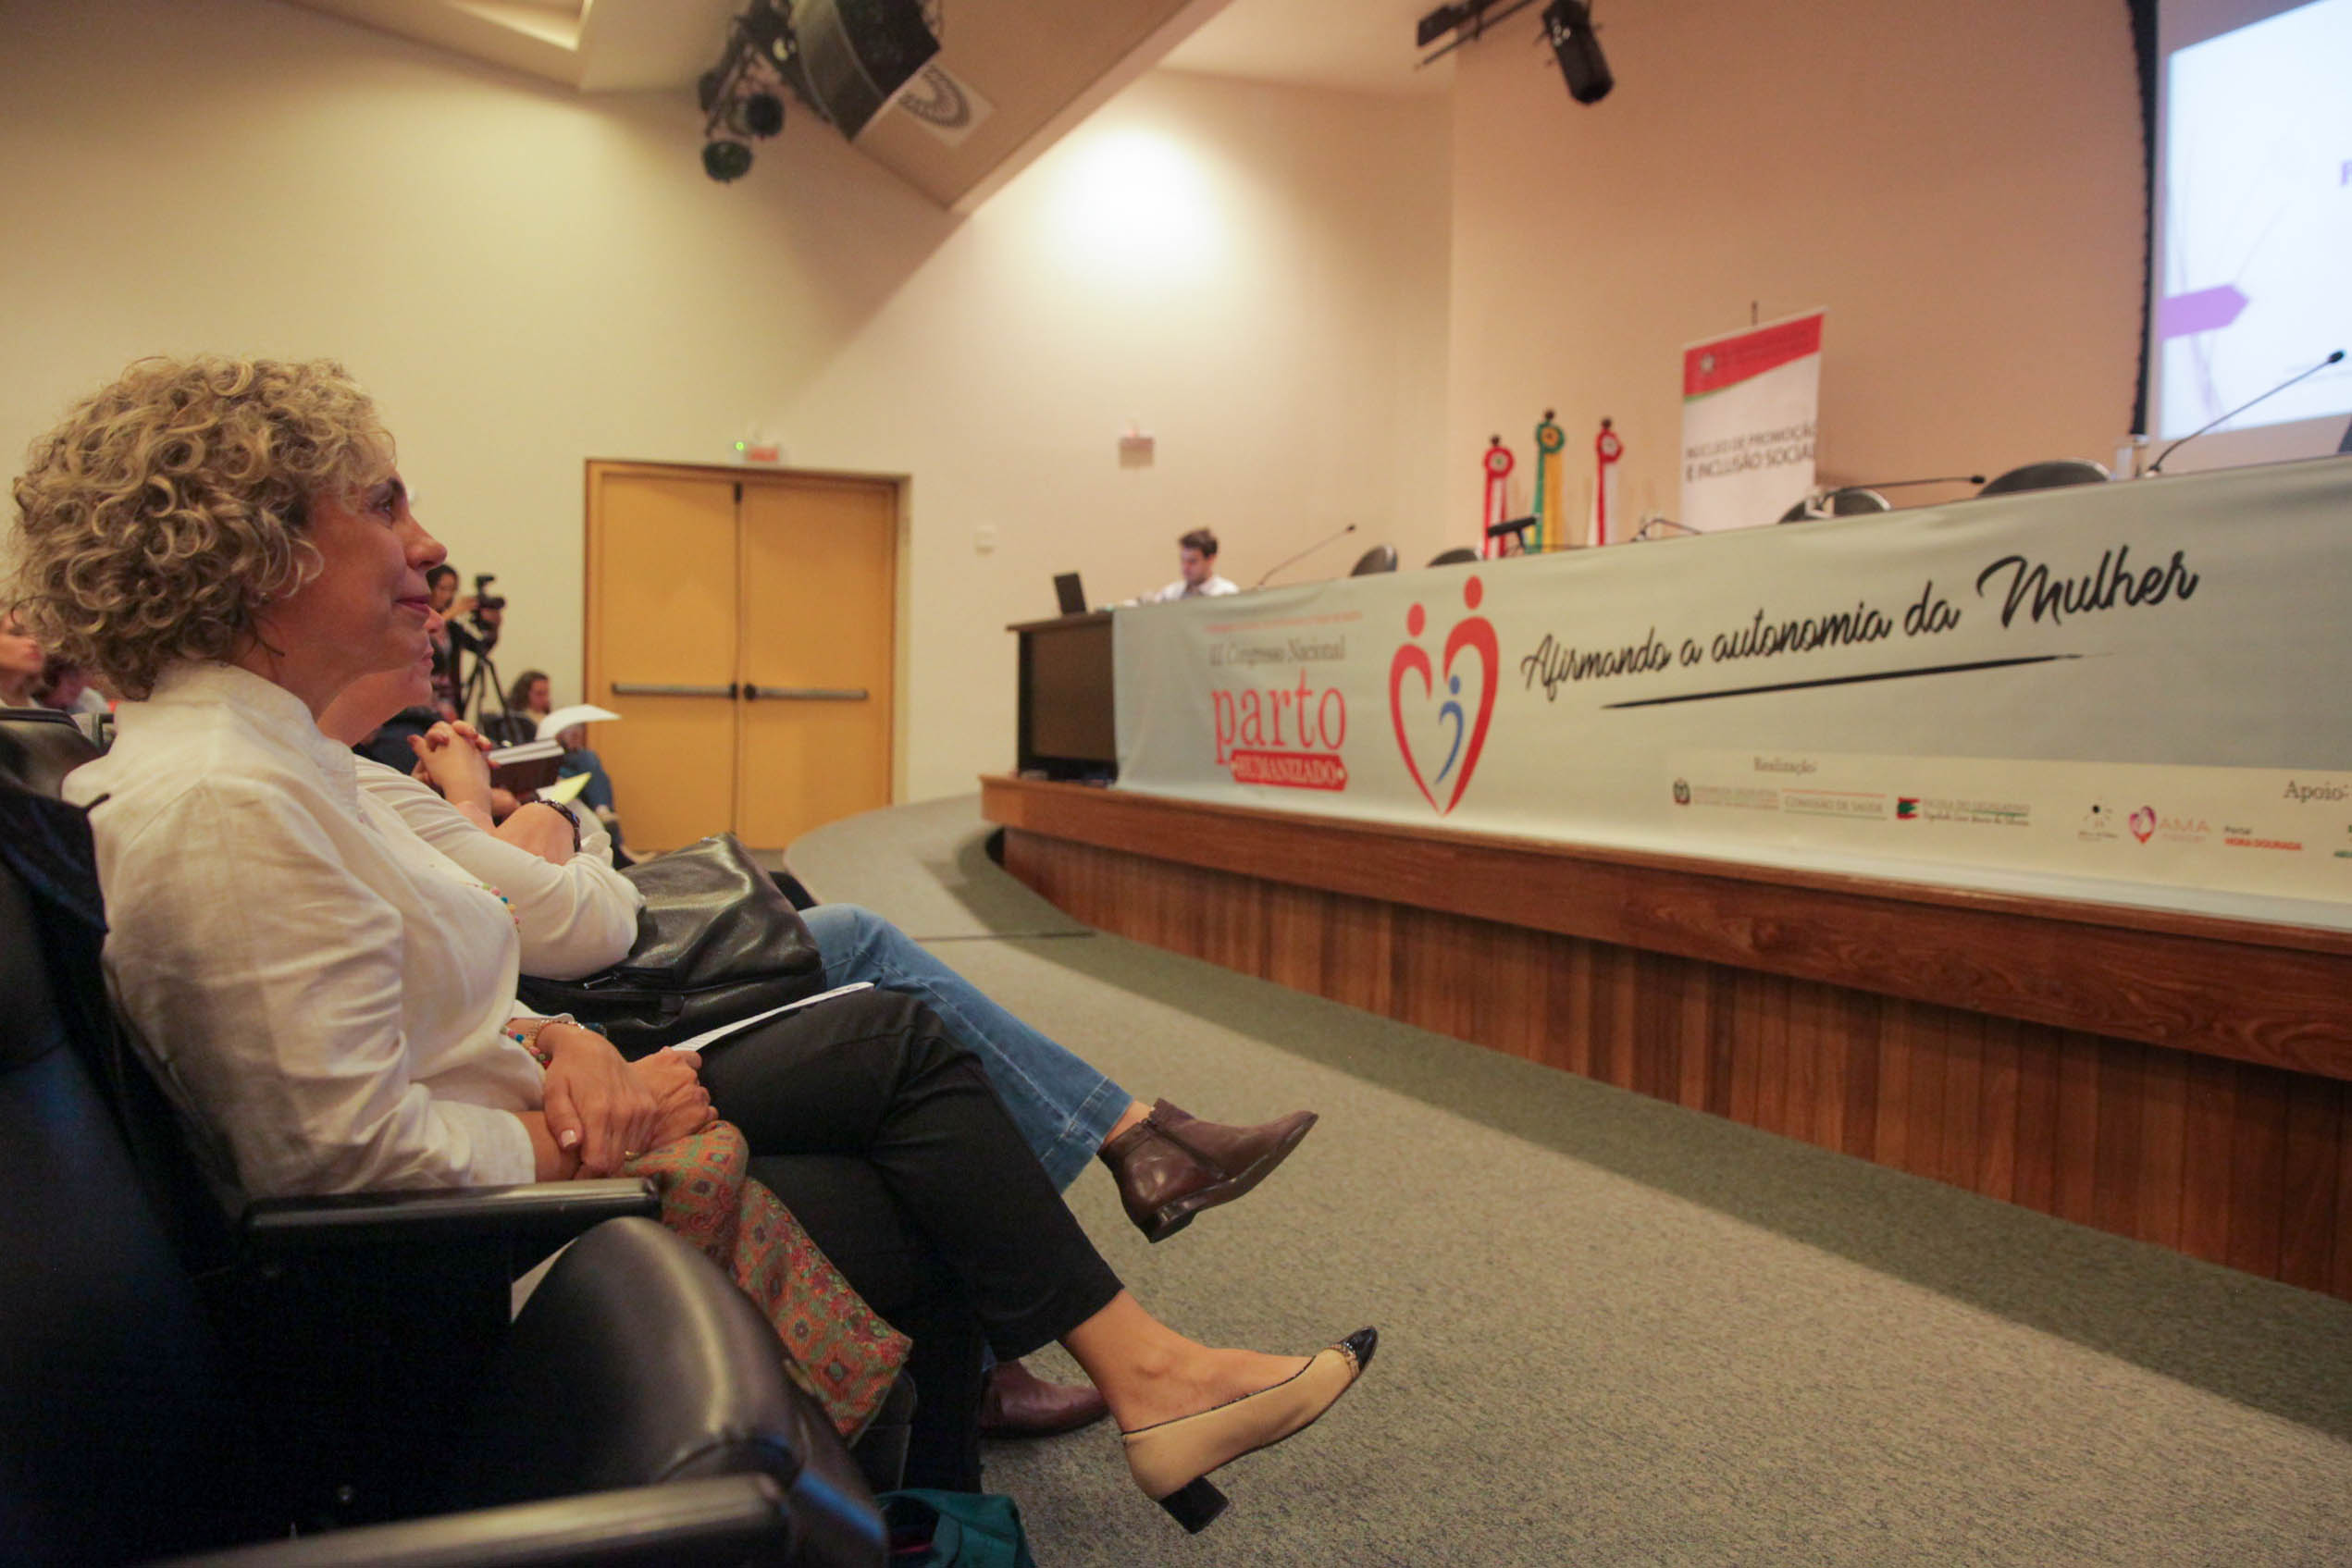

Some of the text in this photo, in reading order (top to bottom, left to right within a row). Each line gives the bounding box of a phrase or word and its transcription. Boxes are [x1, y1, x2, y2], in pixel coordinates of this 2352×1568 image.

[1520, 545, 2199, 703] Afirmando a autonomia da Mulher
[1211, 667, 1347, 766] parto
